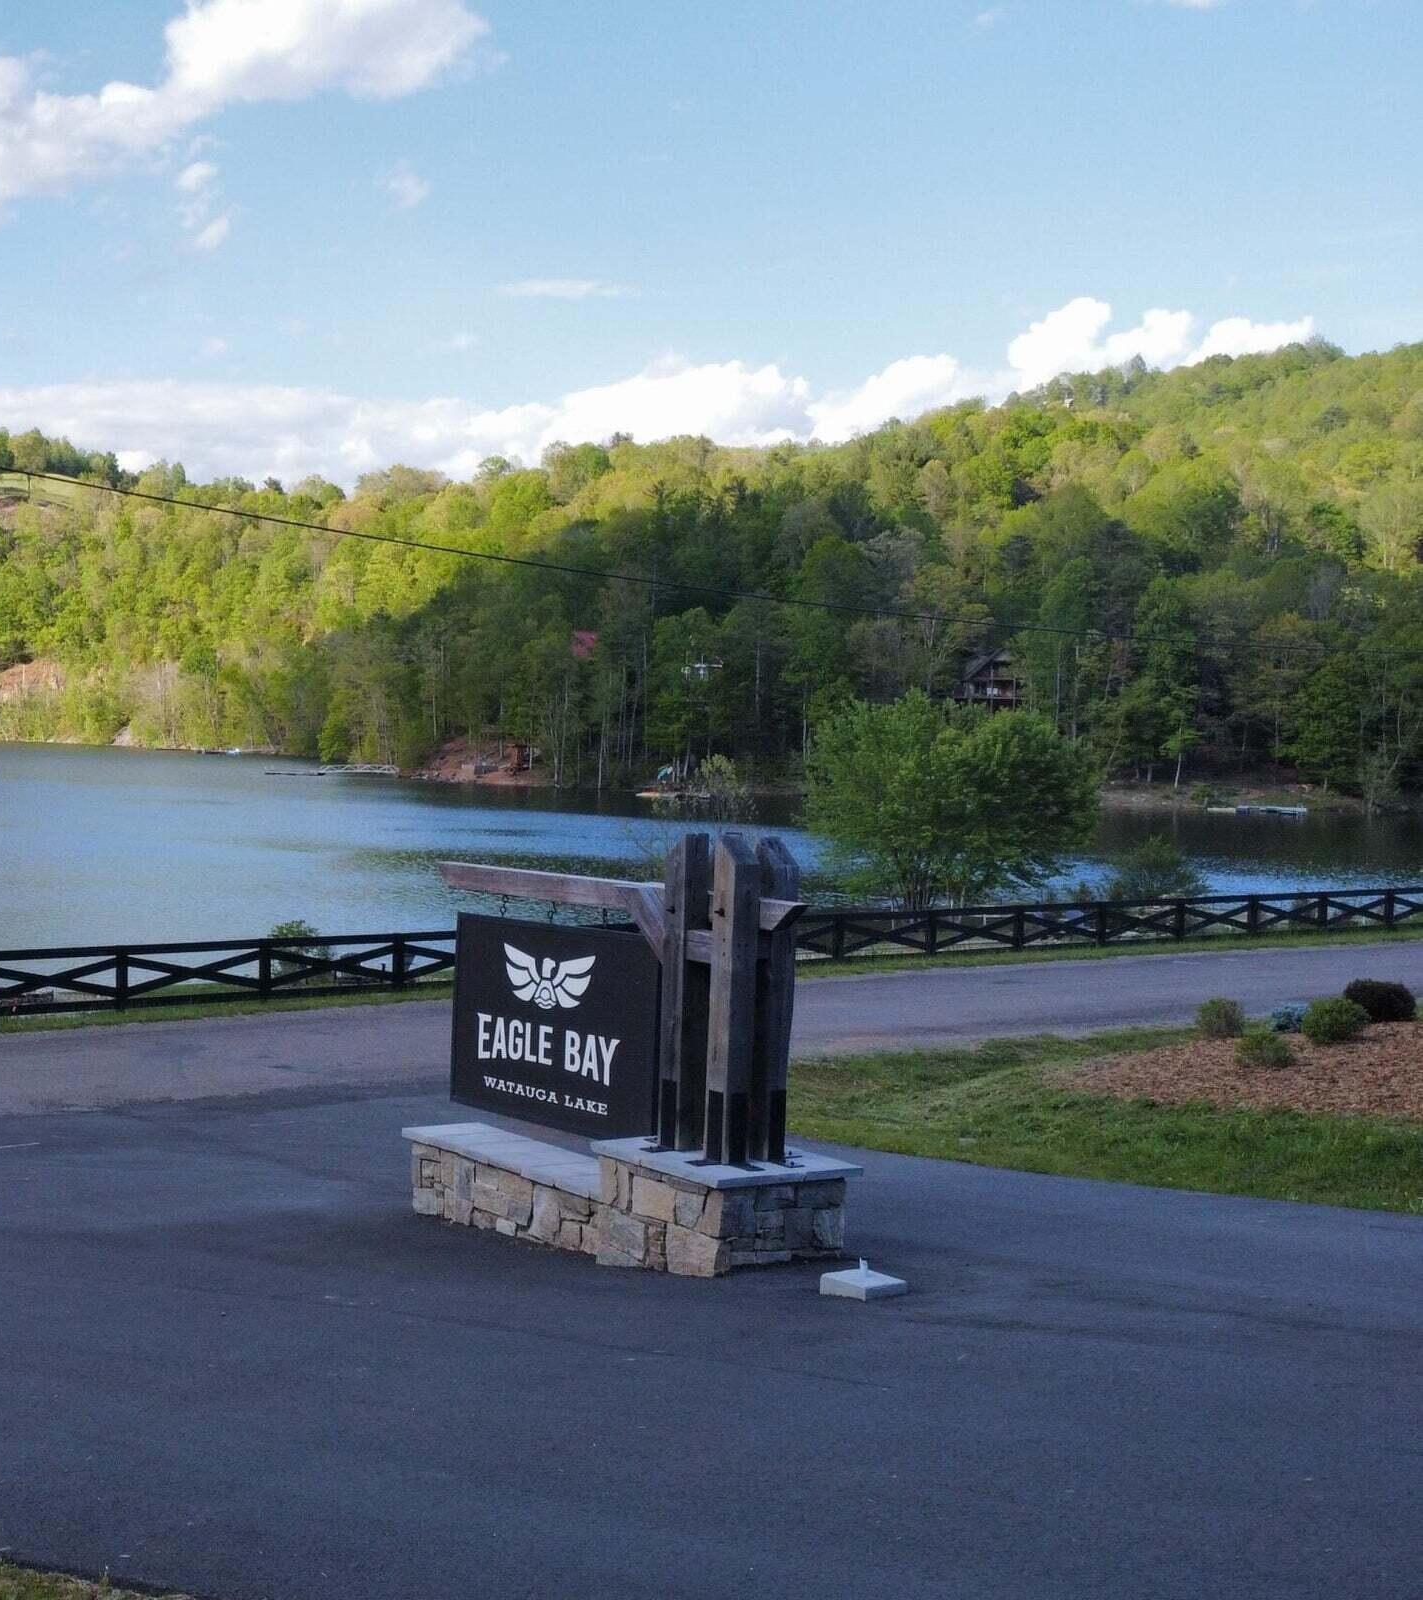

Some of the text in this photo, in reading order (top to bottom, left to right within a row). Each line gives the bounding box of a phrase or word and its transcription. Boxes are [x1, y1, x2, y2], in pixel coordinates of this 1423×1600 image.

[477, 1012, 620, 1086] EAGLE BAY
[483, 1075, 608, 1115] WATAUGA LAKE
